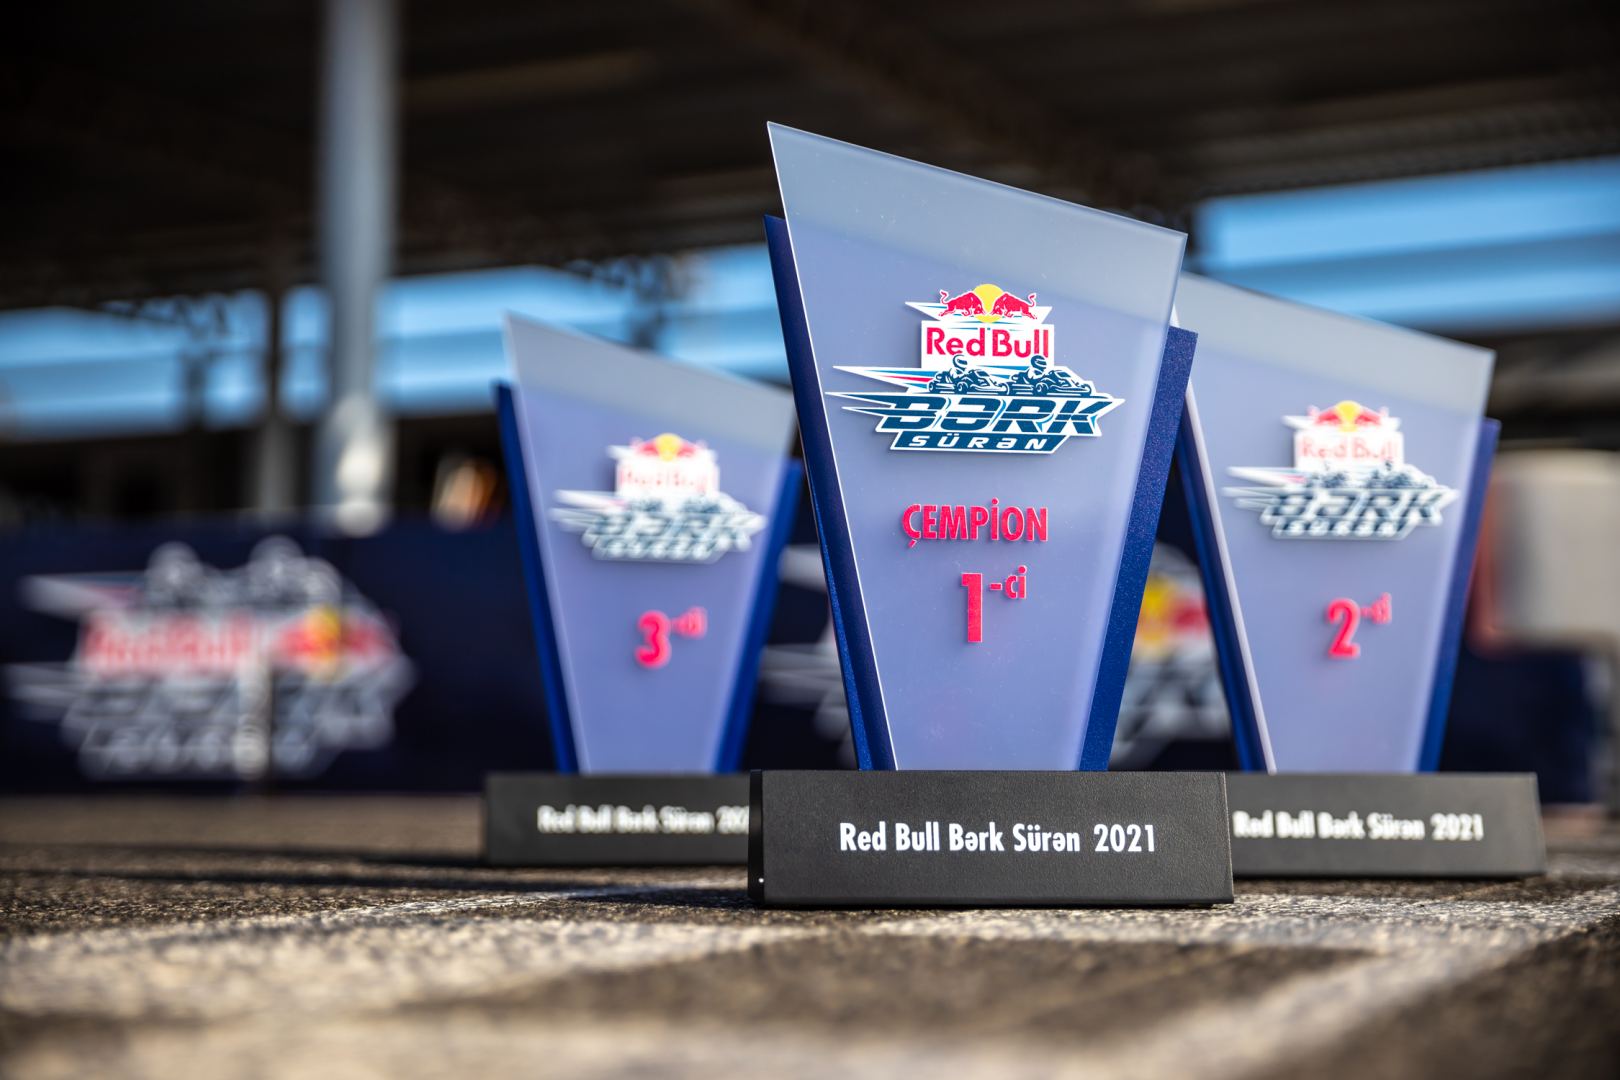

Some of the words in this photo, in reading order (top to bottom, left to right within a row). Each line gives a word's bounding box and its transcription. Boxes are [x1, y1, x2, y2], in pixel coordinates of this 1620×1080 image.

[926, 327, 985, 356] Red
[992, 329, 1049, 358] Bull
[961, 565, 1027, 643] 1-ci
[840, 821, 886, 851] Red
[895, 821, 940, 851] Bull
[949, 821, 1005, 852] Bərk
[1013, 823, 1080, 852] Sürən
[1093, 824, 1155, 852] 2021
[1232, 809, 1274, 838] Red
[1275, 810, 1315, 838] Bull
[1430, 813, 1484, 841] 2021
